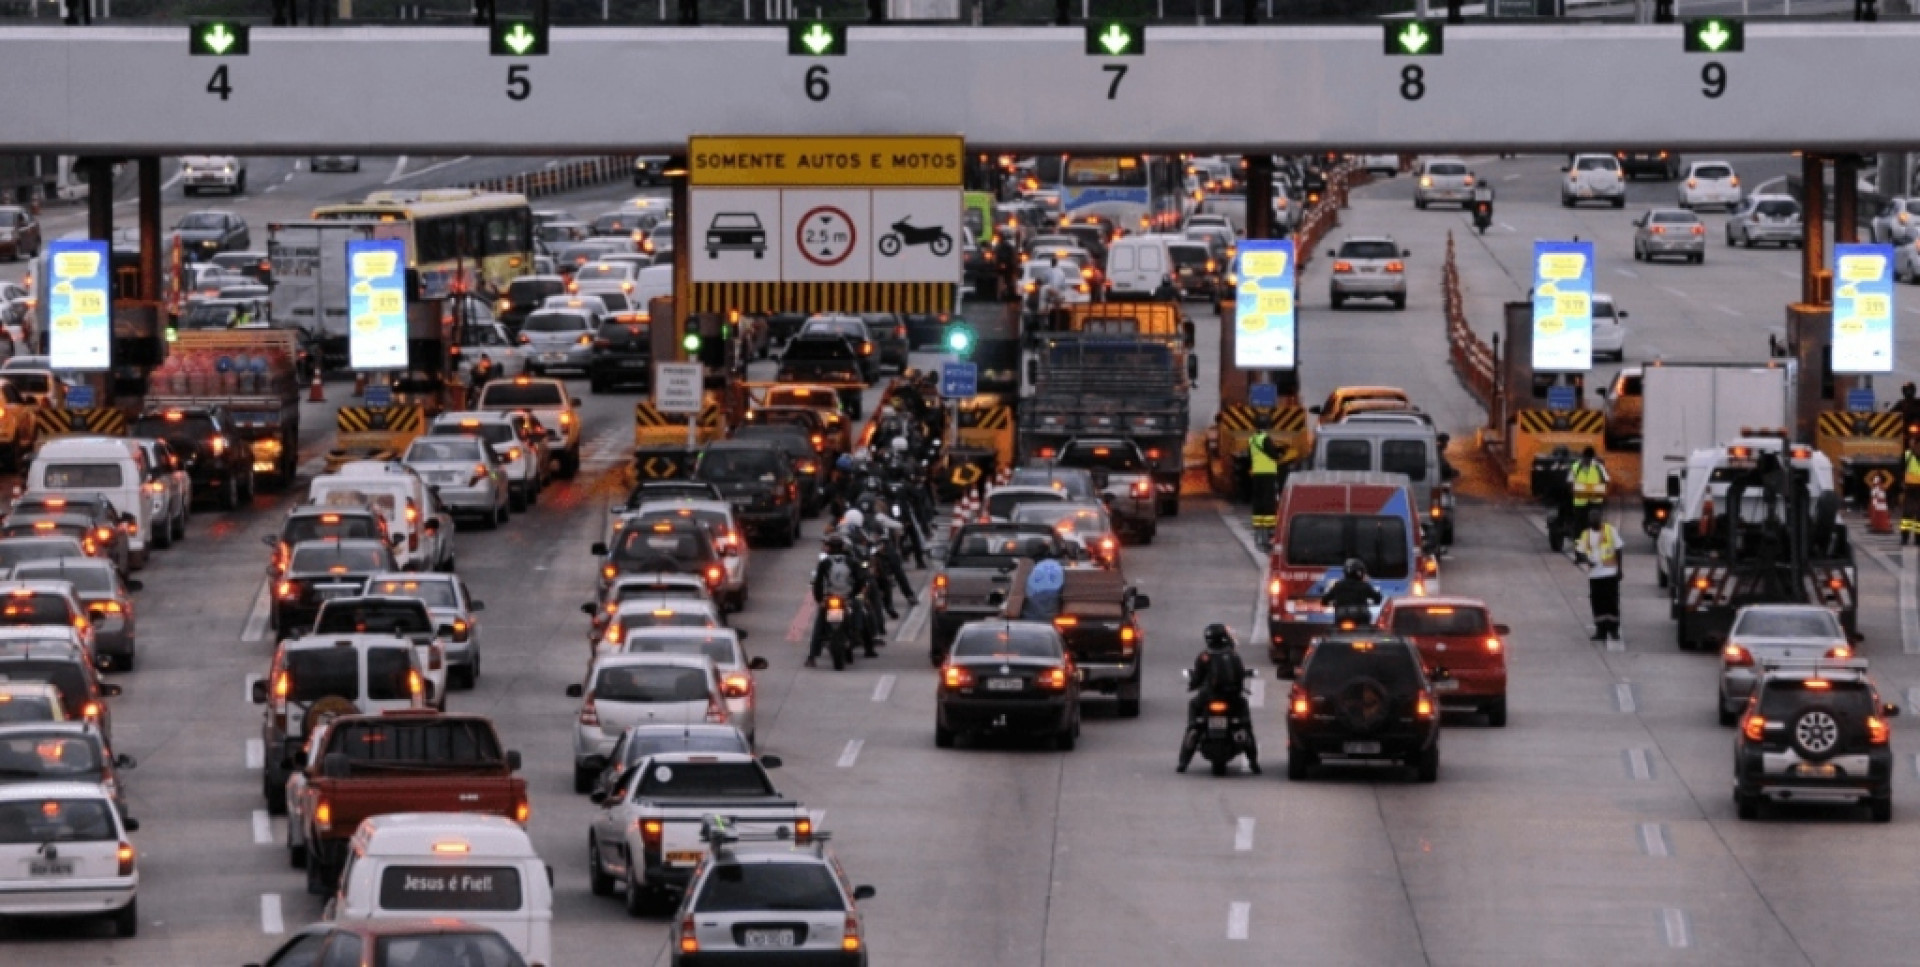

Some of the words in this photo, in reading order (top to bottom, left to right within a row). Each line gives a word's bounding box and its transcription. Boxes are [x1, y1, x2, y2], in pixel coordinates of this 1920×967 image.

[207, 64, 232, 101] 4
[507, 64, 531, 101] 5
[805, 65, 830, 102] 6
[1102, 64, 1128, 100] 7
[1400, 64, 1426, 101] 8
[1701, 62, 1726, 99] 9
[696, 153, 785, 169] SOMENTE
[797, 153, 861, 169] AUTOS
[871, 153, 881, 168] E
[892, 153, 957, 169] MOTOS
[833, 231, 848, 243] m
[404, 874, 445, 891] Jesus
[448, 874, 458, 891] é
